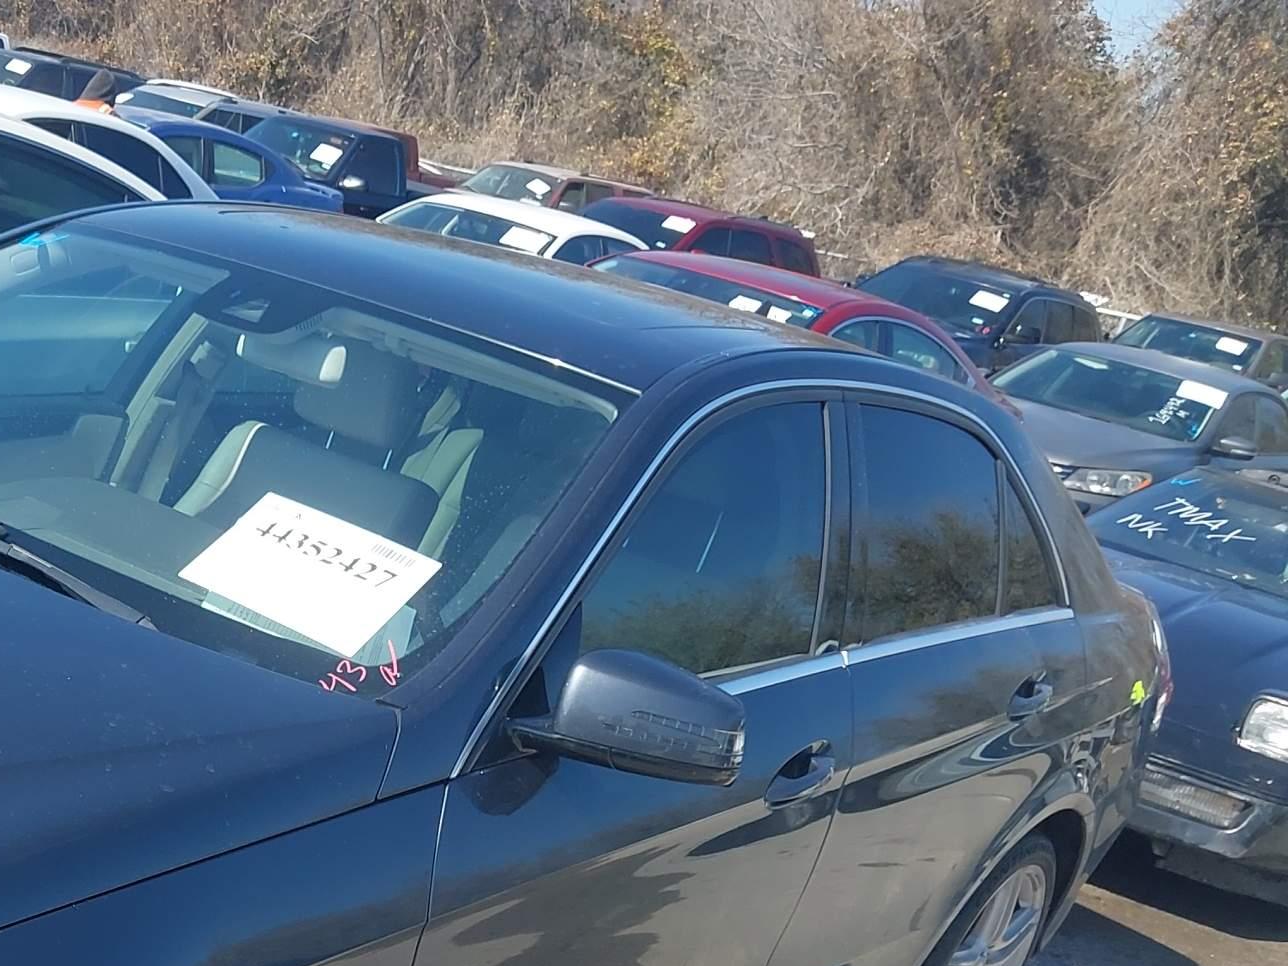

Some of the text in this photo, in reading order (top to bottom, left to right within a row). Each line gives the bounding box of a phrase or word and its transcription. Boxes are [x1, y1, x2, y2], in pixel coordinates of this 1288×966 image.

[1116, 513, 1168, 540] NK
[1153, 497, 1256, 543] TMAX
[255, 522, 399, 588] 44352427
[318, 659, 368, 692] 43
